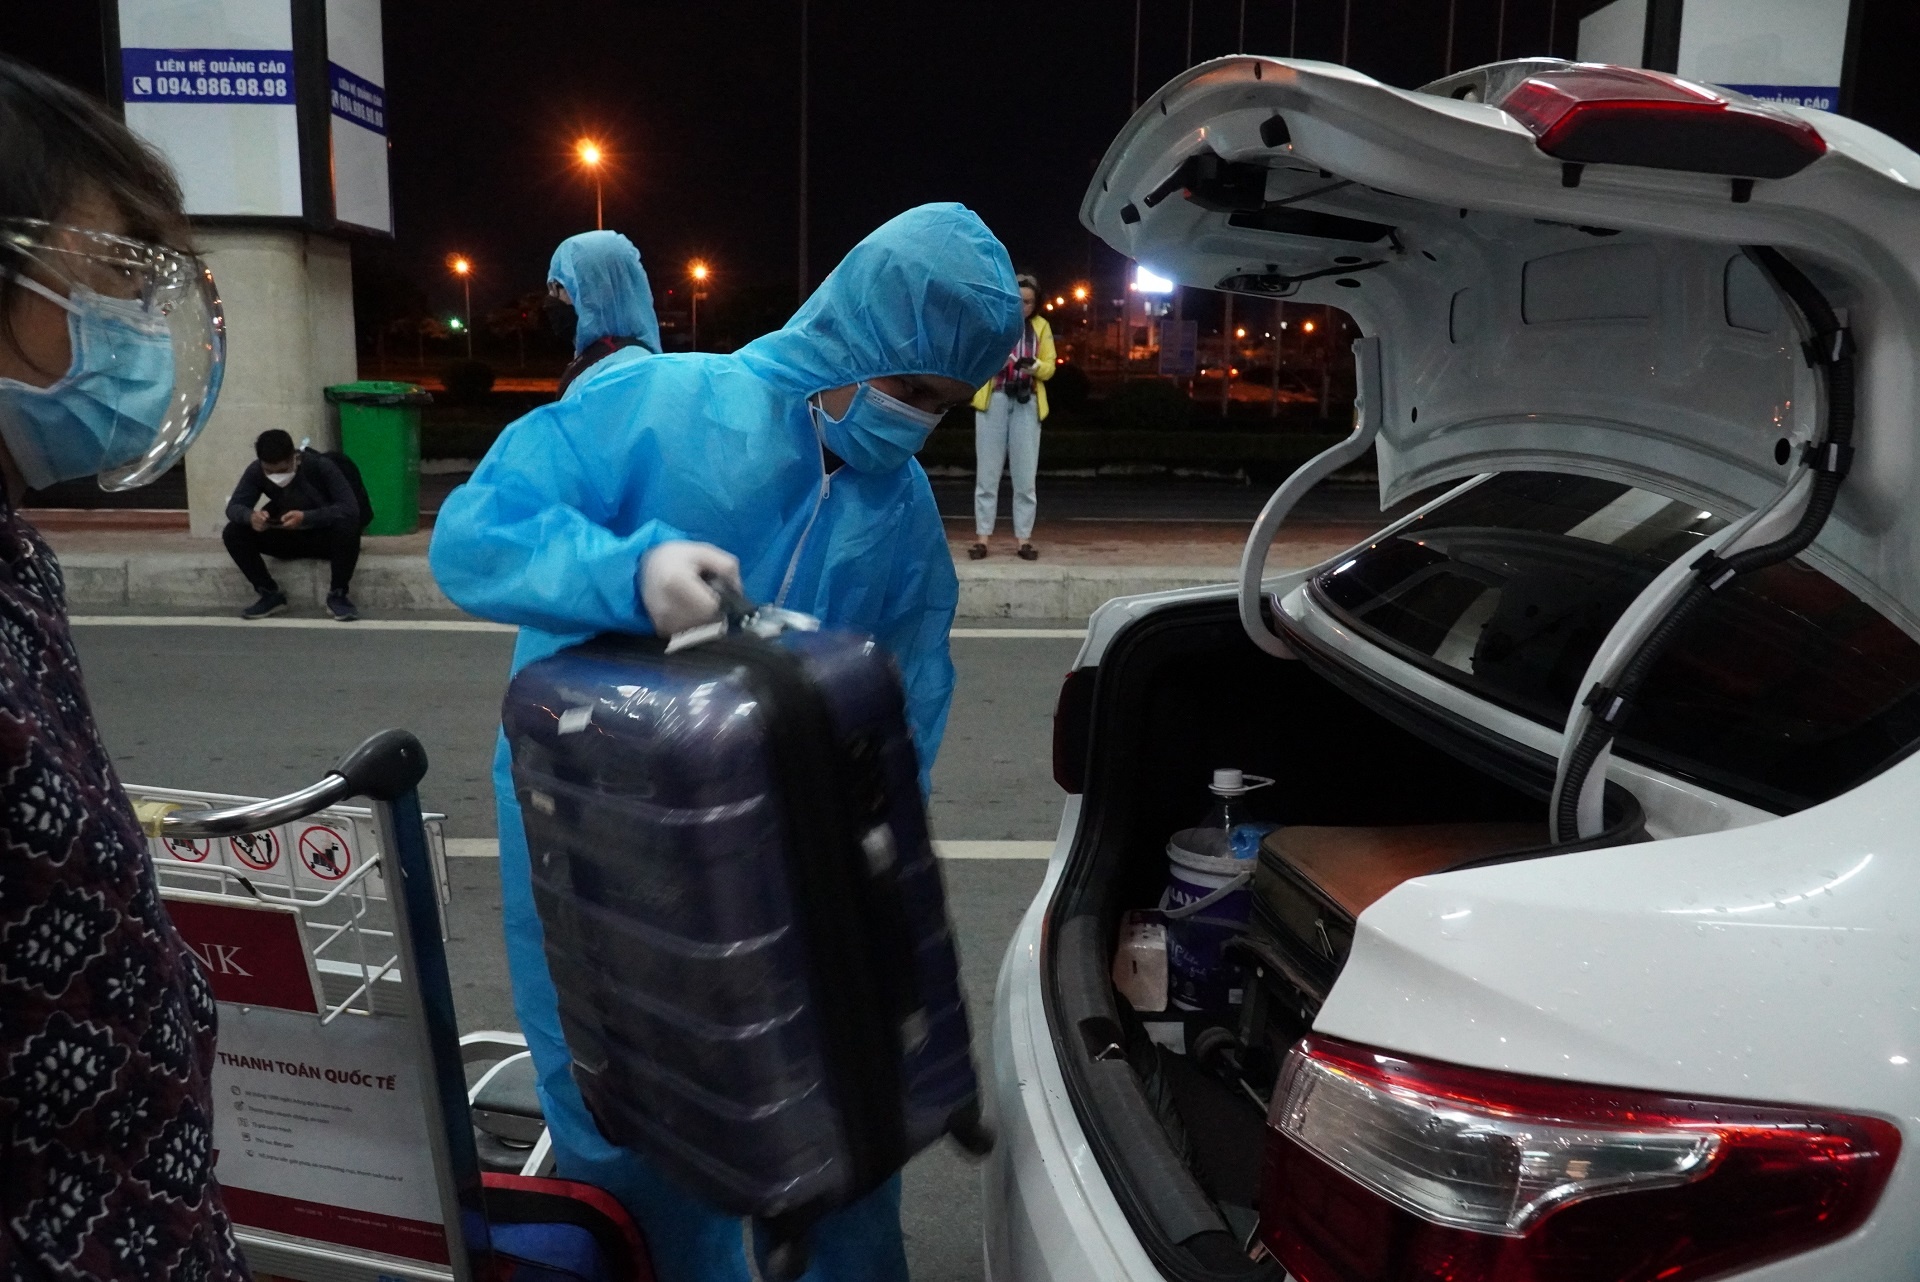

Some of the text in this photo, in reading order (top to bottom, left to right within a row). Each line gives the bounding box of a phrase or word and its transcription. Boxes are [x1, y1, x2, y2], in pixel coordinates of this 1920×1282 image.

[155, 57, 286, 75] LIÊN HỆ QUẢNG CÁO
[157, 77, 287, 97] 094.986.98.98
[1804, 95, 1830, 110] CÁO
[182, 941, 254, 977] NK
[217, 1052, 397, 1091] THANH TOÁN QUỐC TẾ
